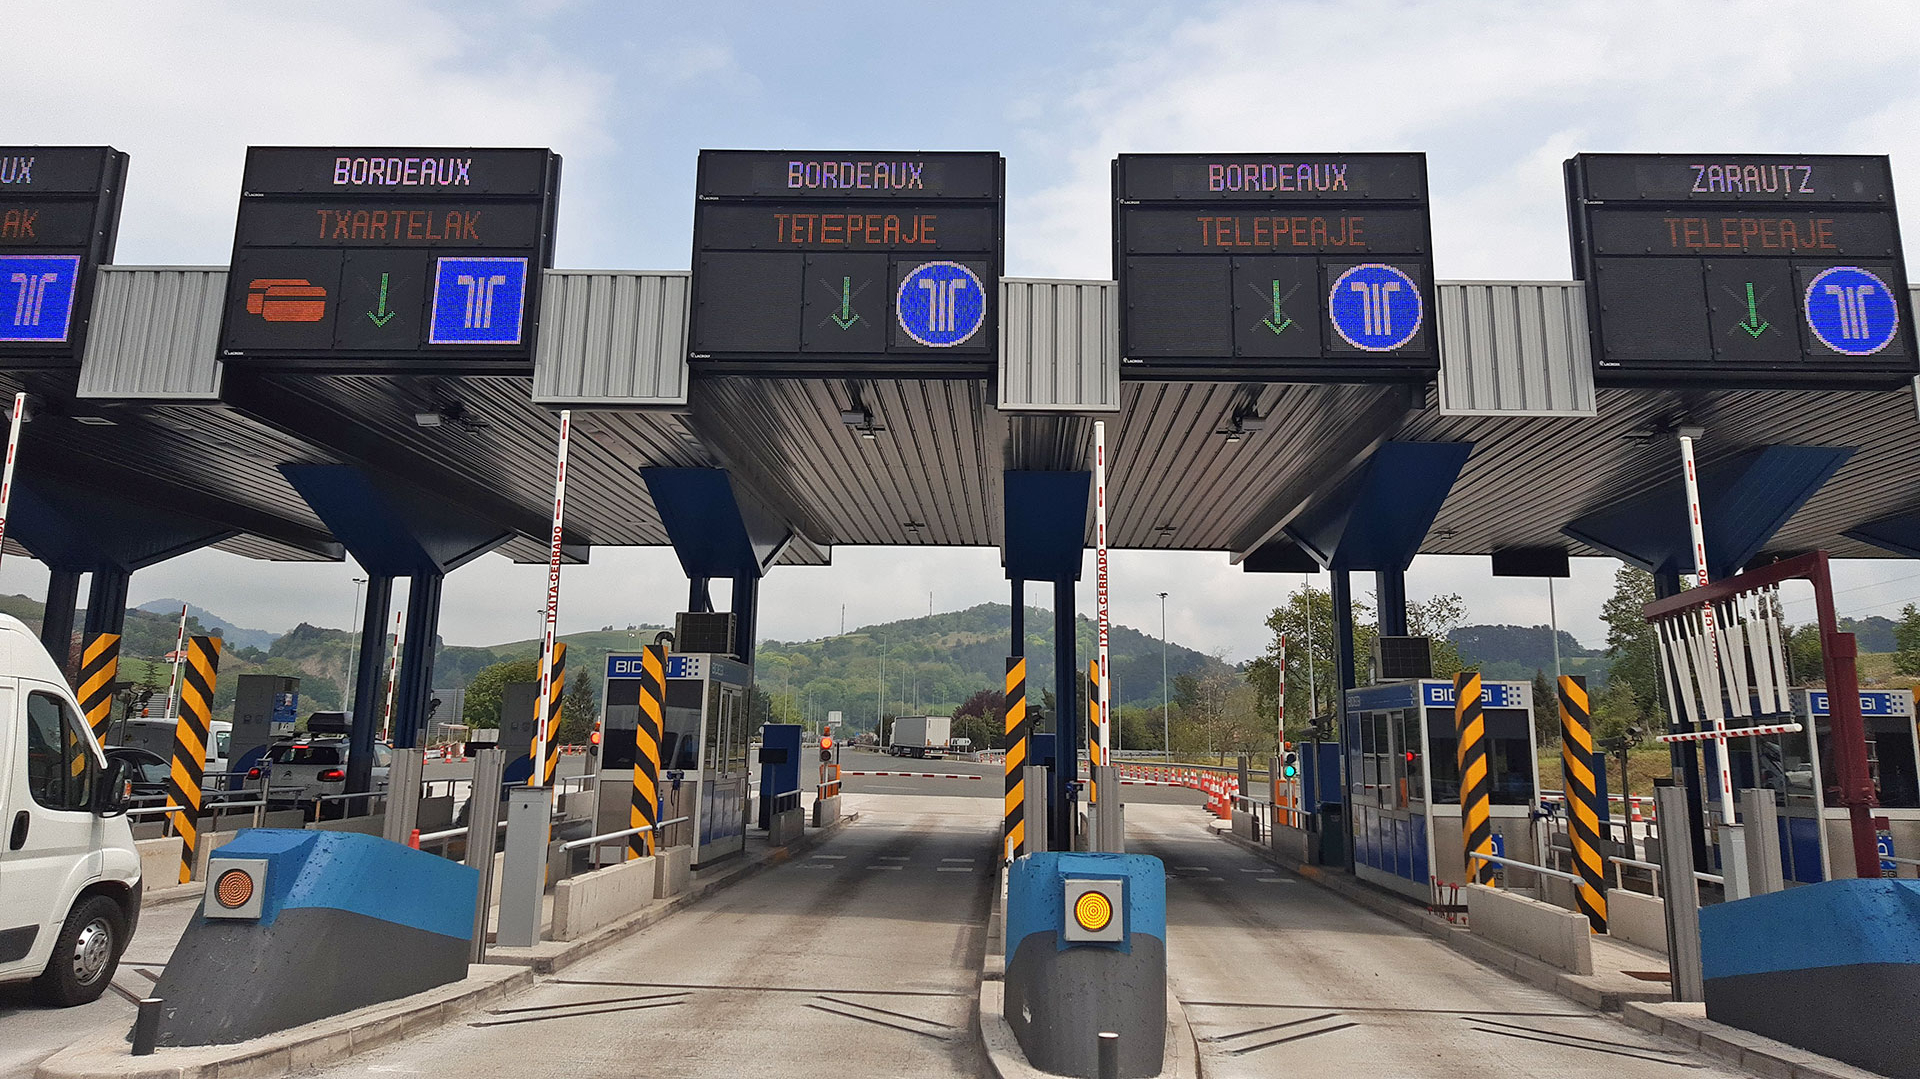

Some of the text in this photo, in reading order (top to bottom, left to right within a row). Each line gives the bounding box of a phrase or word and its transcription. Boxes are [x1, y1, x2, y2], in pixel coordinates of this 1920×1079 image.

[333, 157, 472, 186] BORDEAUX
[787, 161, 924, 190] BORDEAUX
[1208, 163, 1348, 192] BORDEAUX
[1690, 165, 1815, 194] ZARAUTZ
[318, 209, 482, 240] TXARTELAK
[774, 214, 937, 245] TETEPEAJE
[1198, 216, 1365, 247] TELEPEAJE
[1665, 218, 1837, 249] TELEPEAJE
[615, 660, 672, 673] BIDI
[1431, 688, 1493, 702] BIDGI
